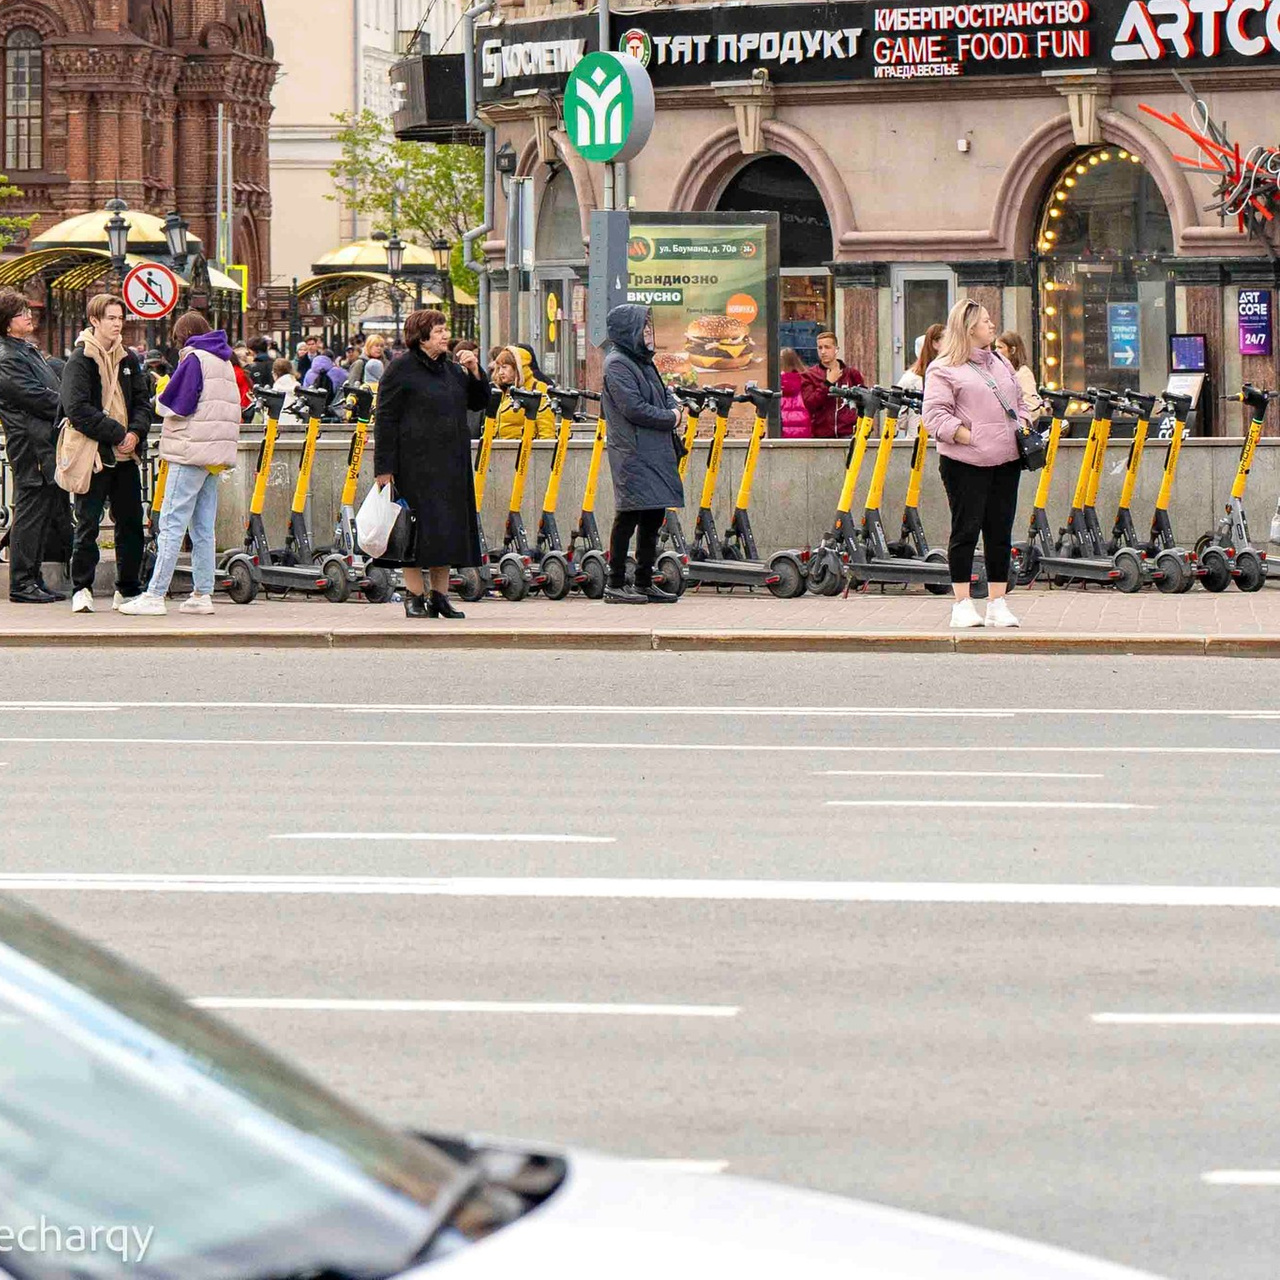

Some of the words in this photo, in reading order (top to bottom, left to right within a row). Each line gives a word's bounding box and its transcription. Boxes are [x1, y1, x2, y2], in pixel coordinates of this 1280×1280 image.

[874, 0, 1088, 31] КИБЕРПРОСТРАНСТВО
[652, 34, 711, 65] ТАТ
[717, 27, 864, 65] ПРОДУКТ
[873, 35, 950, 65] GAME.
[957, 32, 1028, 61] FOOD.
[1037, 29, 1087, 58] FUN
[627, 272, 719, 287] Грандиозно
[627, 291, 681, 304] вкусно
[1239, 291, 1260, 303] ART
[1239, 303, 1267, 315] CORE
[1245, 333, 1266, 345] 24/7
[349, 430, 363, 480] WHOOSH
[1239, 429, 1255, 475] WHOOSH
